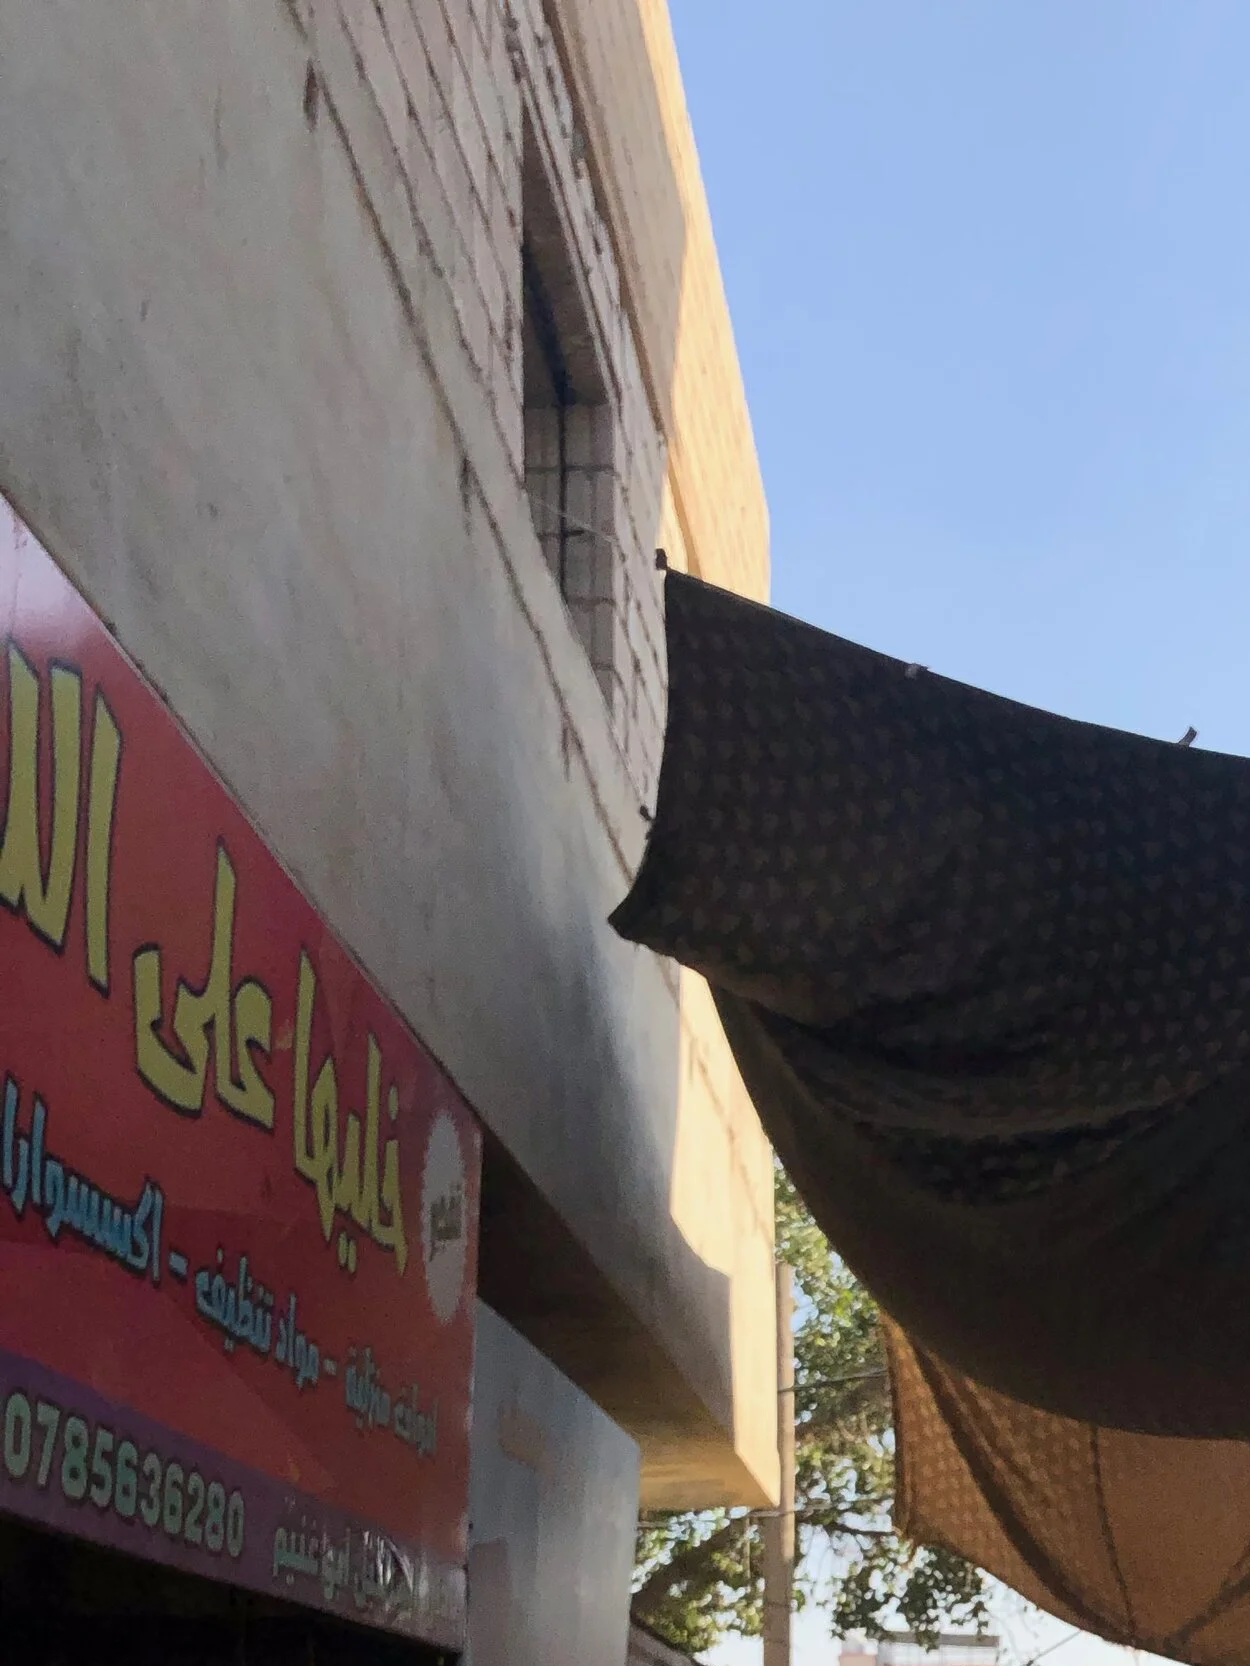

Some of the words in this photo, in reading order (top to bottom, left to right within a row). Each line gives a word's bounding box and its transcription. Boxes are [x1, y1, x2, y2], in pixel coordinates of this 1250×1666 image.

[0, 638, 121, 998] الل
[134, 836, 274, 1133] على
[294, 950, 407, 1277] خليها
[196, 1247, 274, 1353] تنظيف
[275, 1292, 320, 1390] مواد
[3, 1391, 246, 1560] 0785636280
